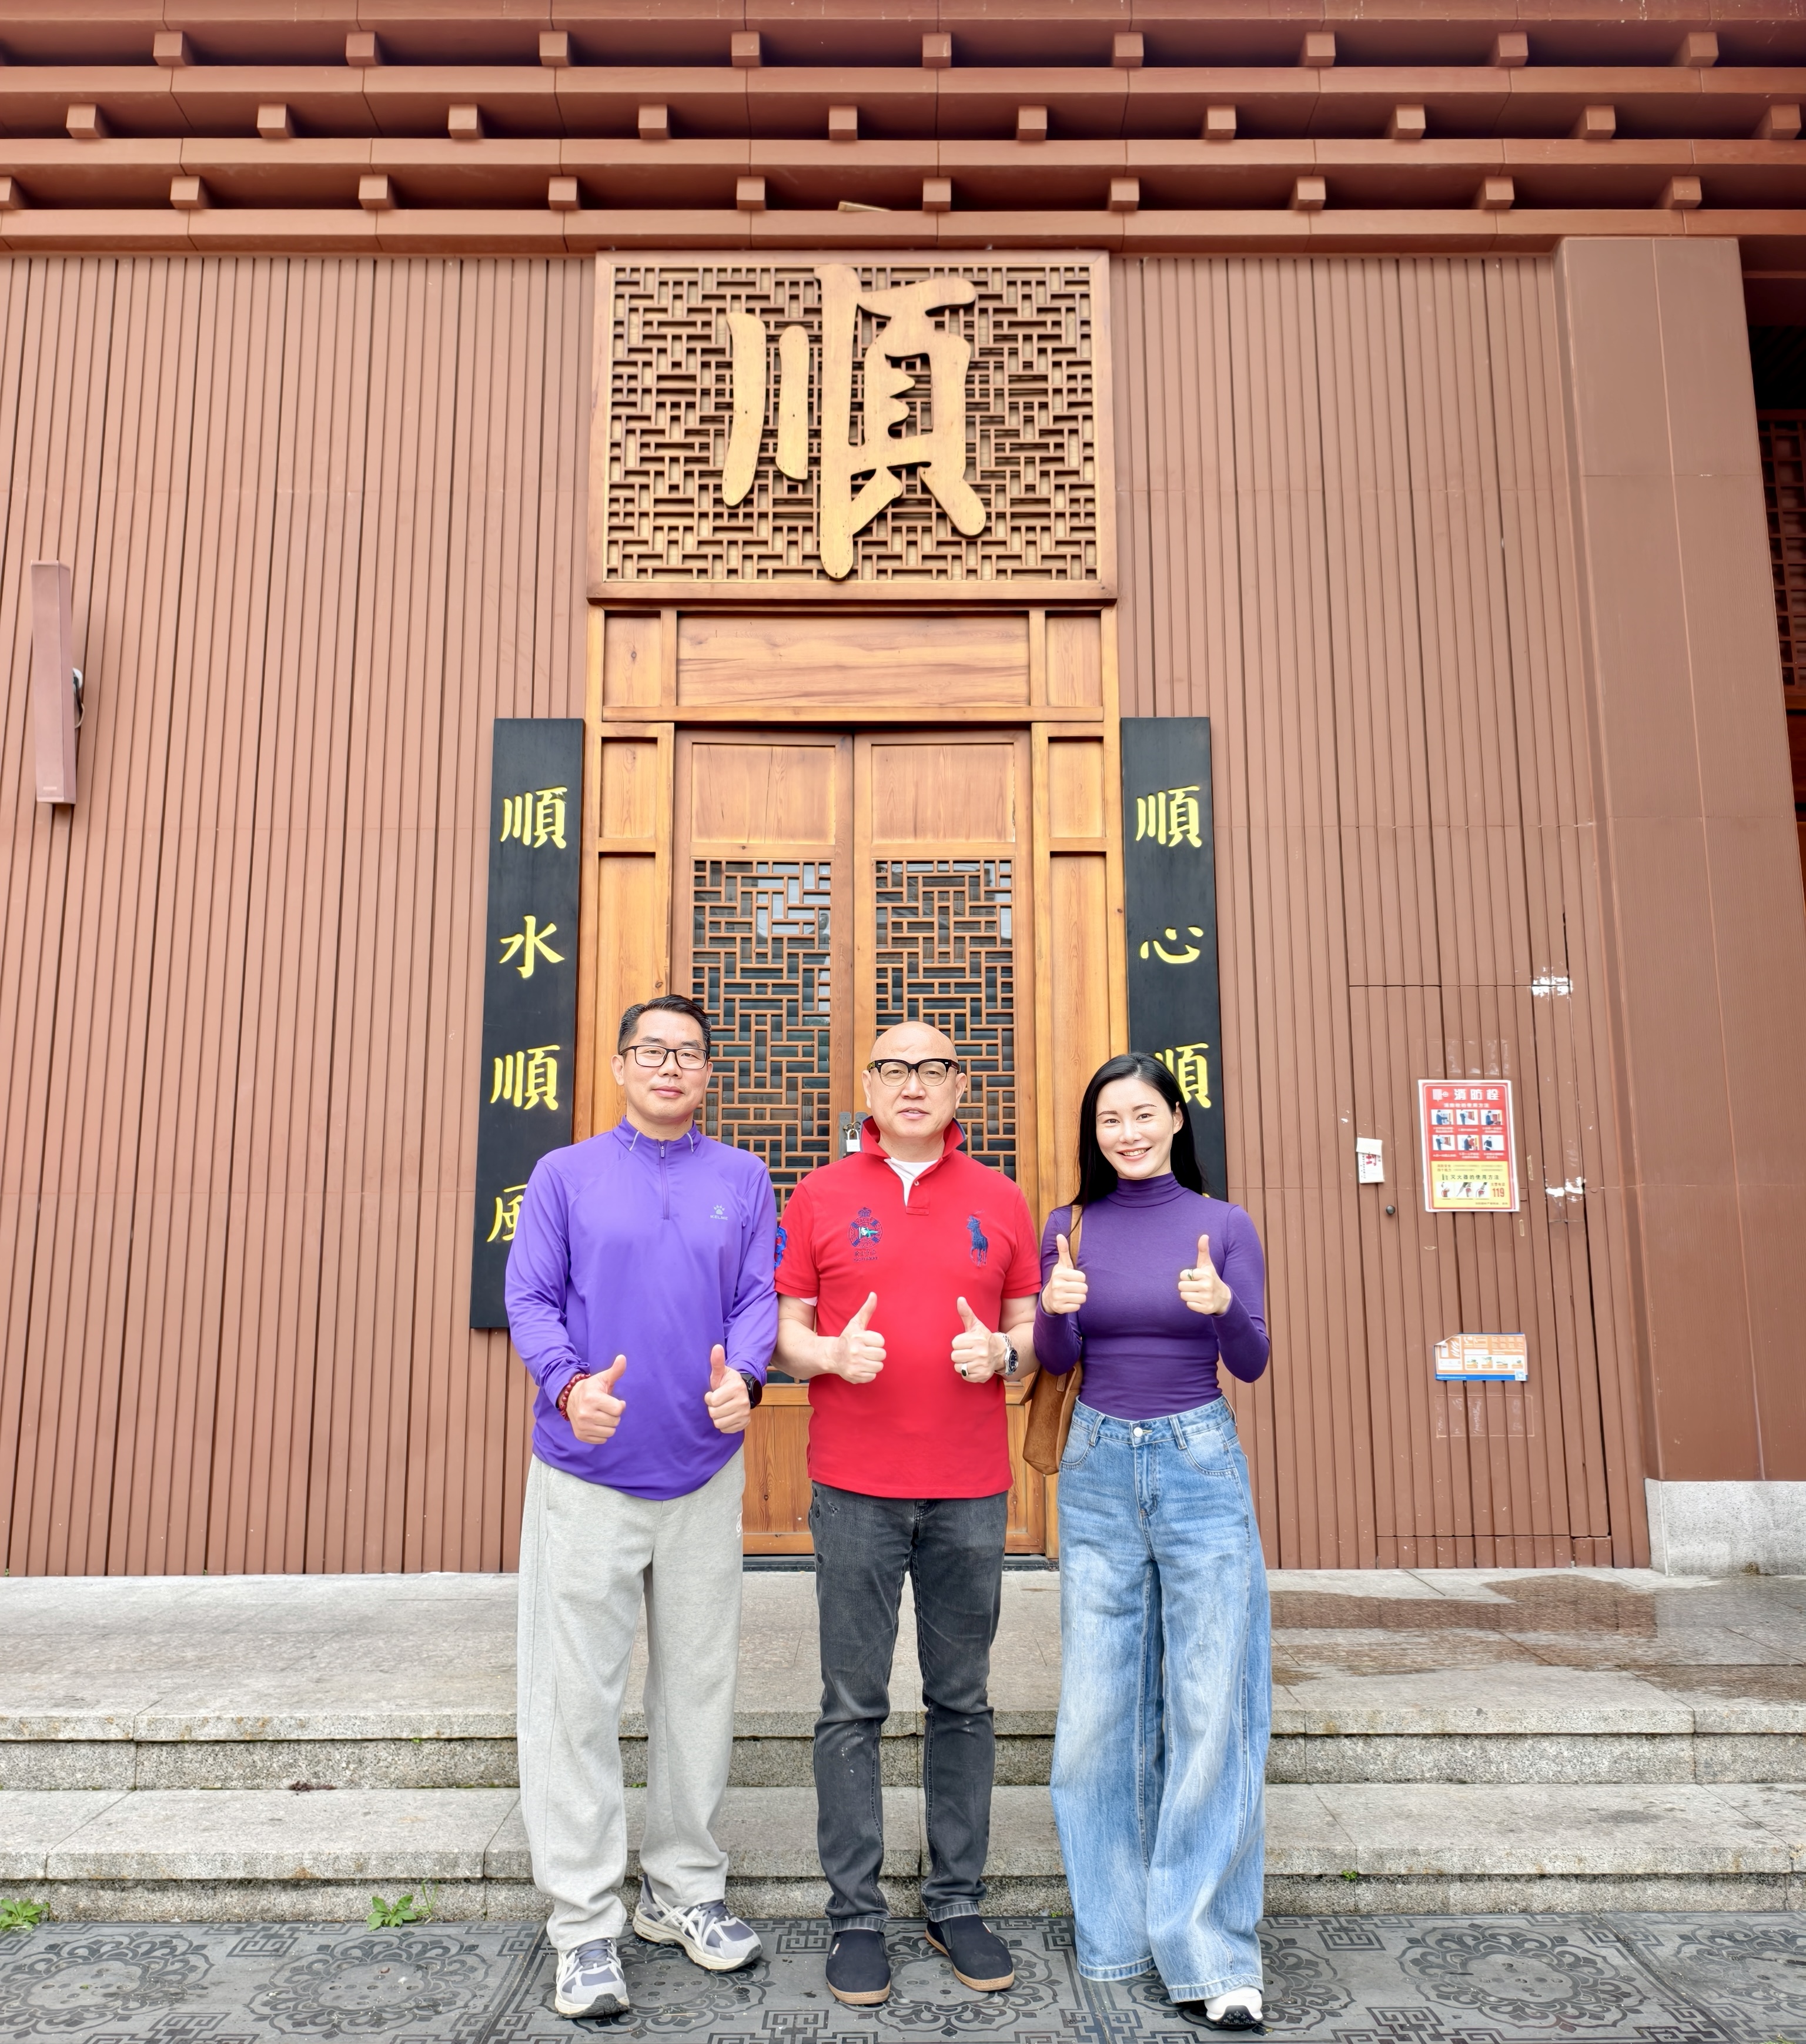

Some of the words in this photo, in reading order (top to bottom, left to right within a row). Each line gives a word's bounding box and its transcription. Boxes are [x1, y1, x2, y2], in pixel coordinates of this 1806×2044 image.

[722, 263, 987, 581] 順
[1454, 1089, 1500, 1100] 消防栓
[1492, 1187, 1505, 1197] 119
